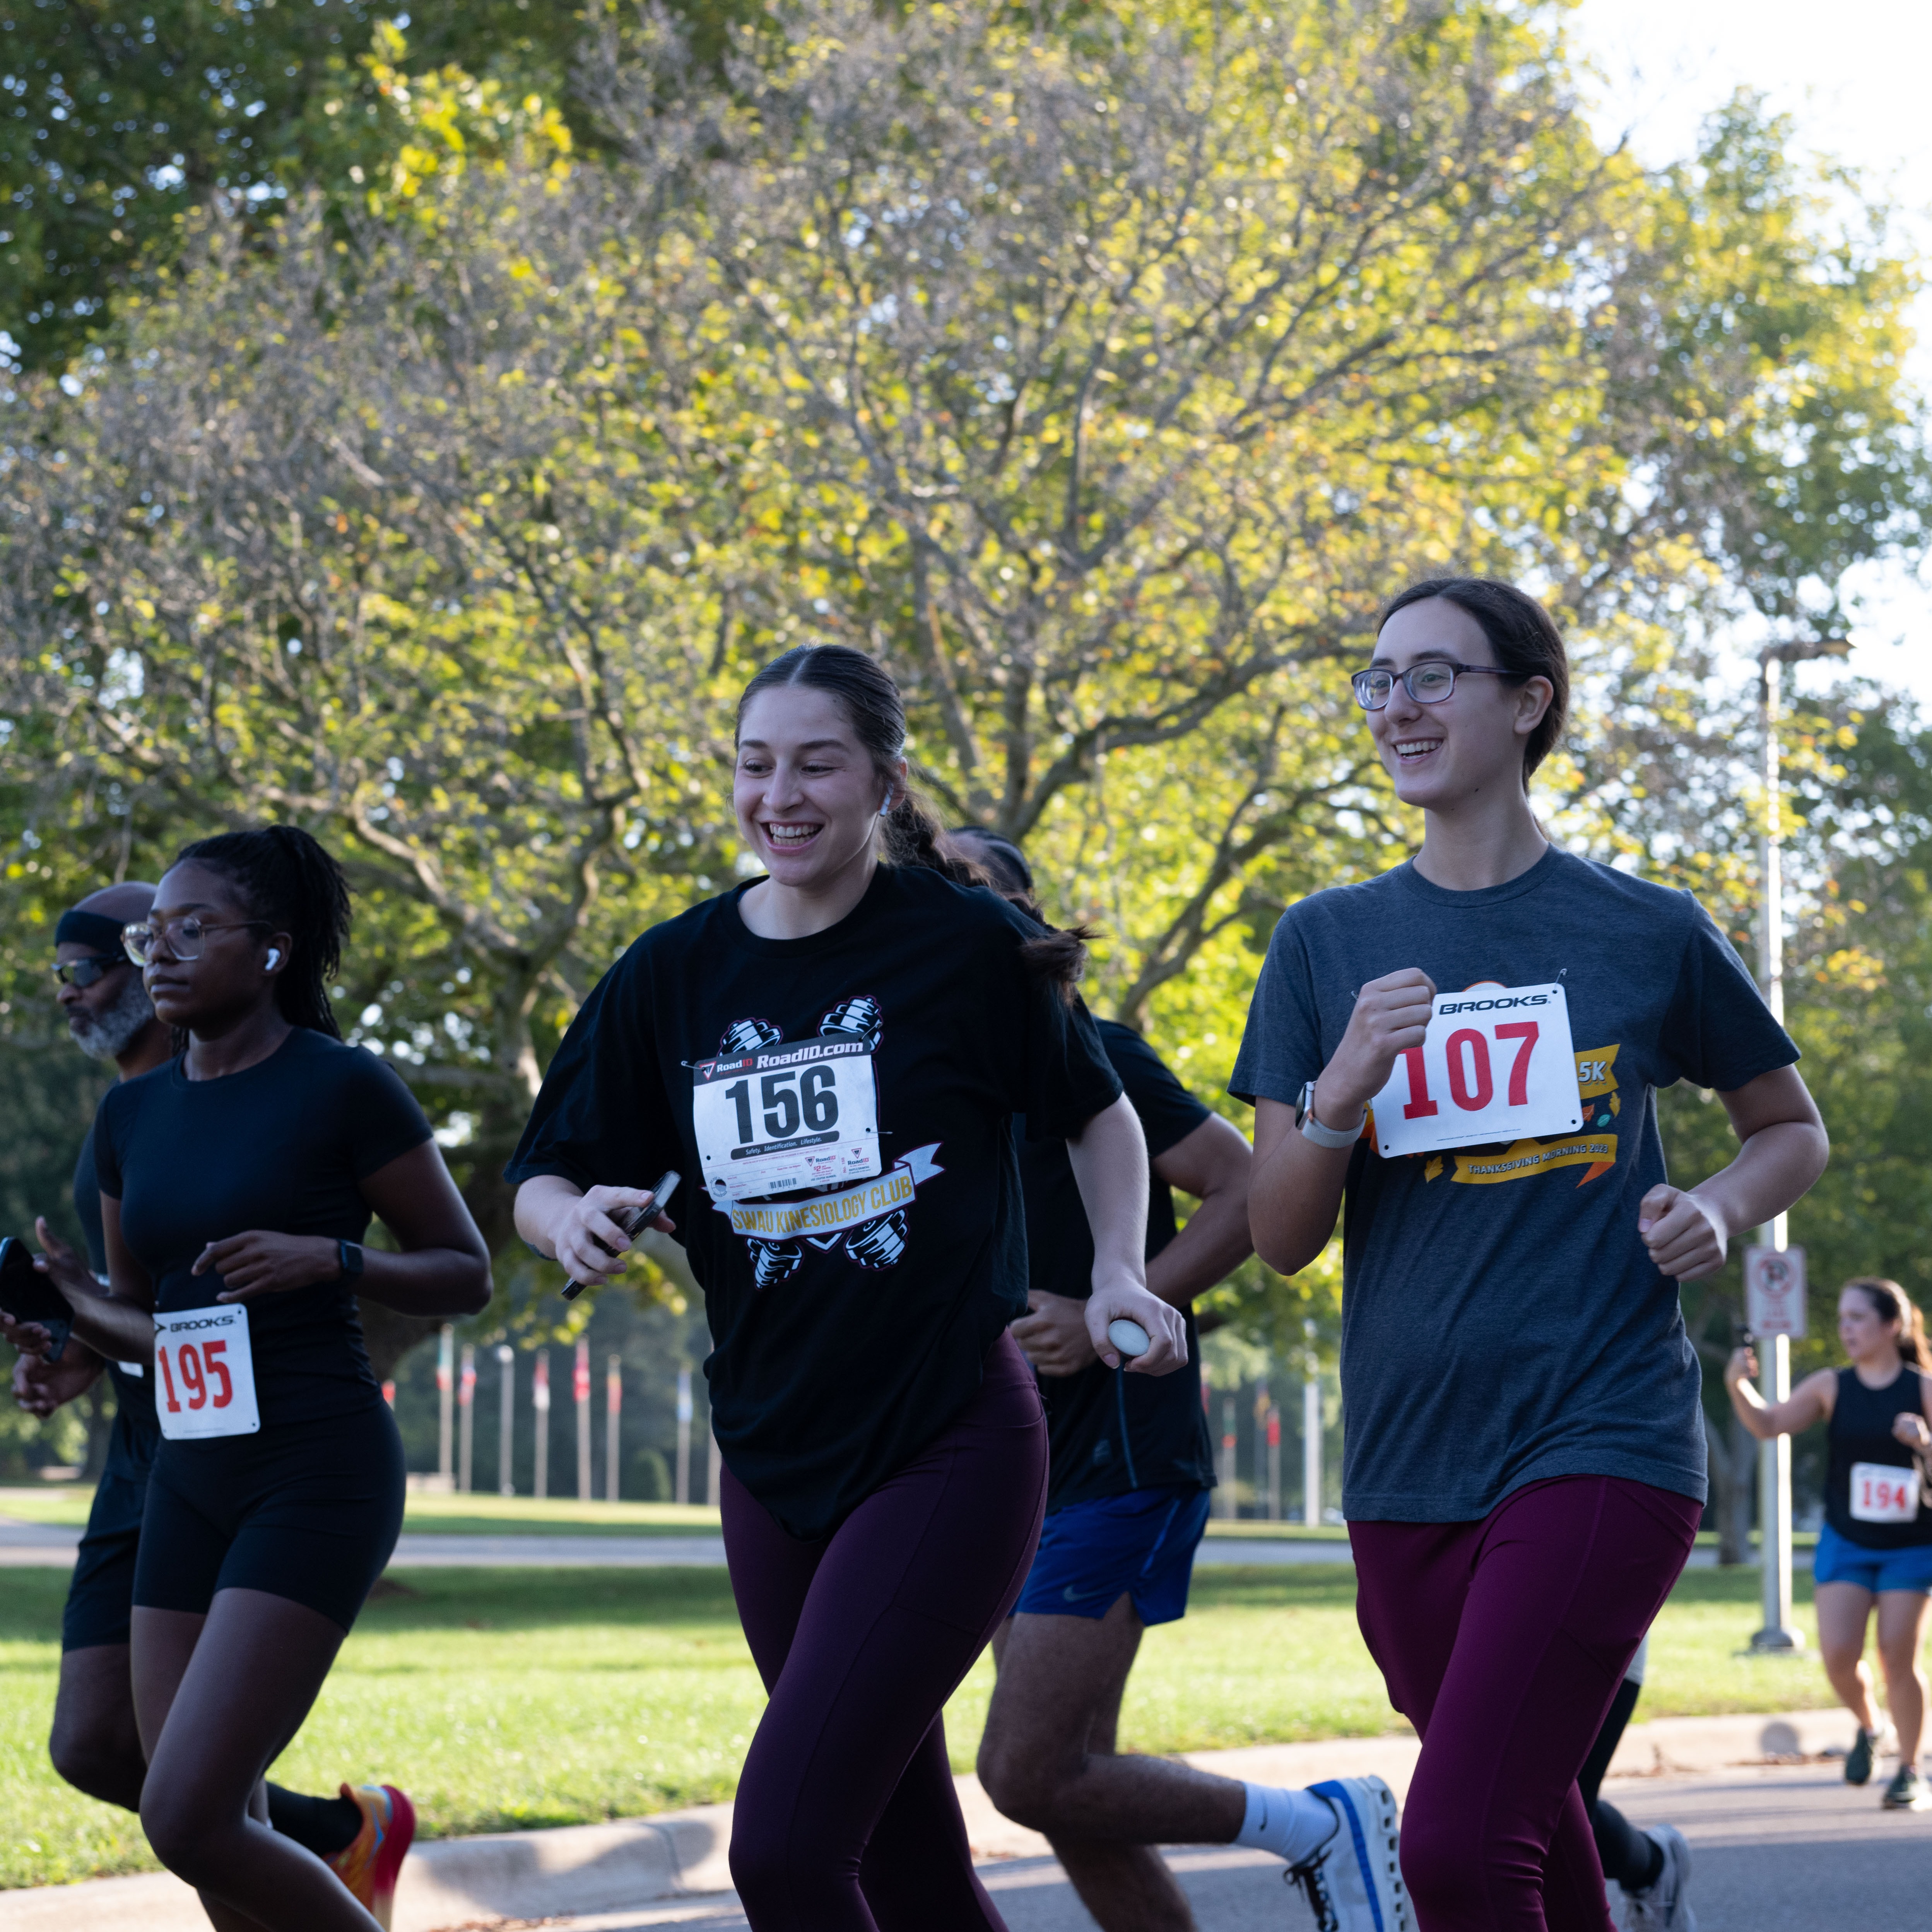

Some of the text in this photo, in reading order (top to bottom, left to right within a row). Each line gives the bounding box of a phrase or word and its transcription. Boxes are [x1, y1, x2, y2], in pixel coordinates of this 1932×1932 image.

[1439, 995, 1548, 1015] BROOKS
[717, 1042, 863, 1072] RoadID RoadID.com
[1398, 1021, 1539, 1120] 107
[1578, 1060, 1607, 1083] 5K
[725, 1065, 839, 1145] 156
[764, 1141, 798, 1152] Identification.
[800, 1137, 822, 1145] Lifestyle.
[1467, 1143, 1608, 1174] THANKSGIVING MORNING 2023
[732, 1175, 912, 1233] SWAU KINESIOLOGY CLUB
[170, 1315, 234, 1332] BROOKS
[158, 1339, 234, 1413] 195
[1863, 1481, 1906, 1511] 194
